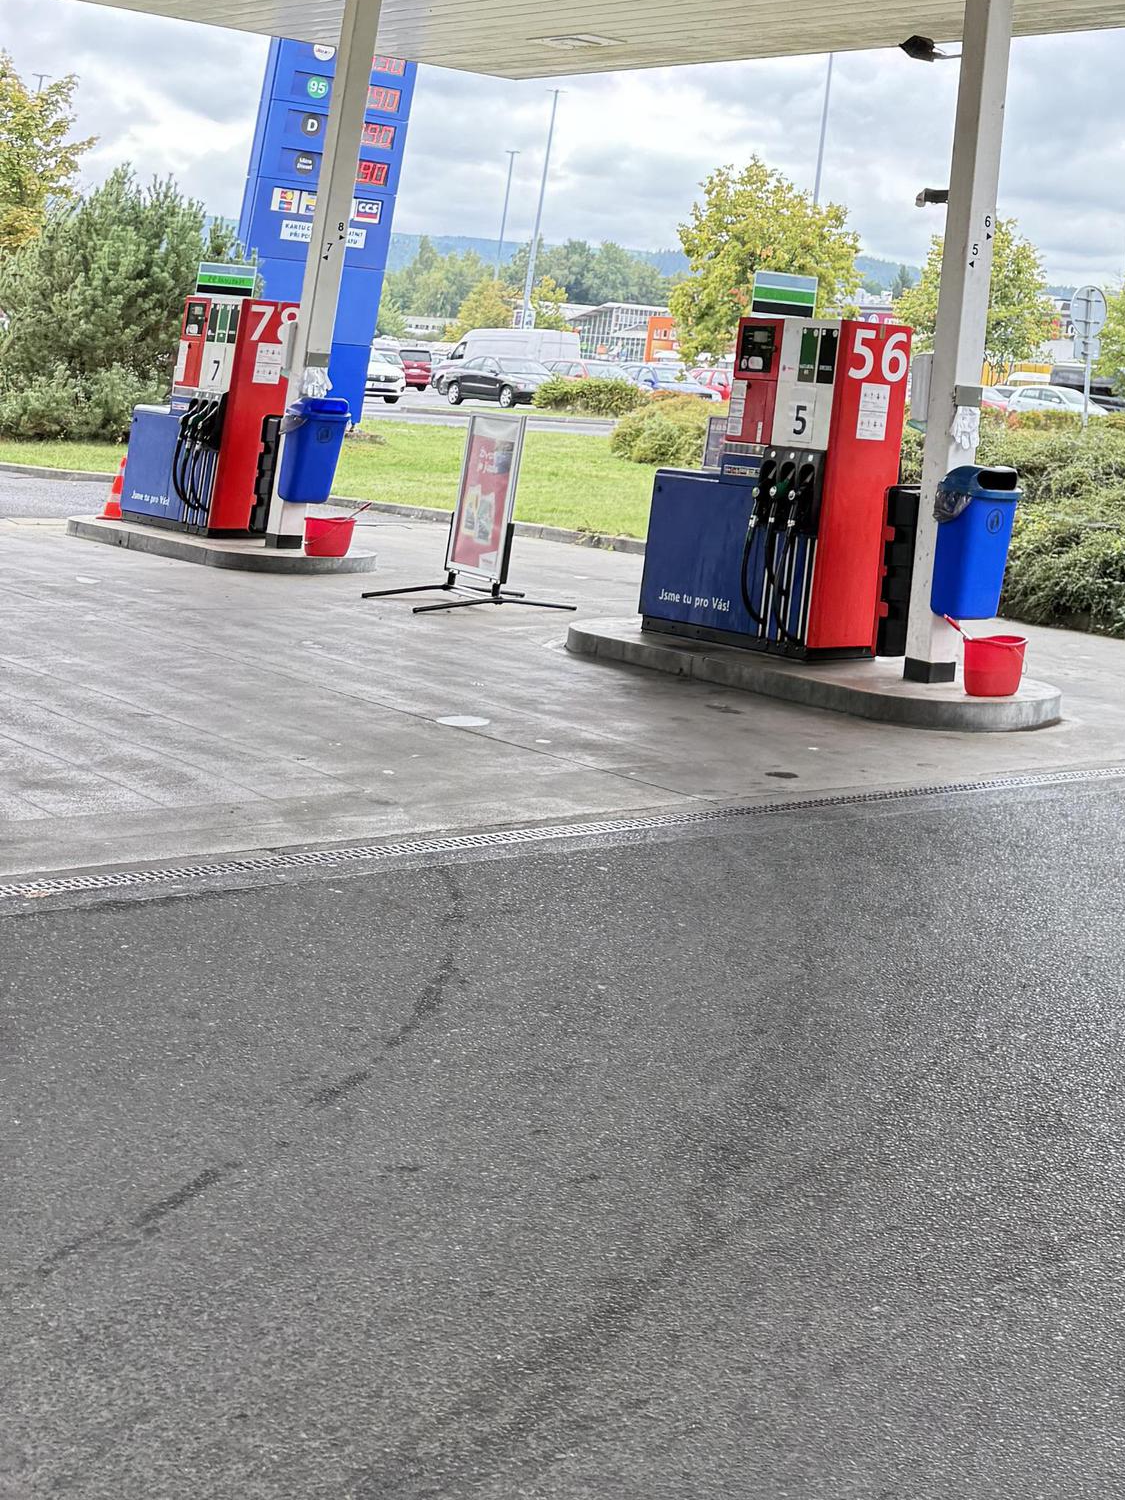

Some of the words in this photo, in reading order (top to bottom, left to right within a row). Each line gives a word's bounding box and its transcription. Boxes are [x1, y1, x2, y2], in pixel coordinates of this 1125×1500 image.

[309, 80, 326, 95] 95
[307, 119, 318, 131] D
[358, 202, 379, 214] CCS
[338, 222, 344, 231] 8
[985, 216, 991, 228] 6
[327, 243, 333, 252] 7
[972, 244, 979, 255] 5
[848, 328, 908, 382] 56
[212, 360, 220, 381] 7
[793, 405, 807, 435] 5
[659, 588, 680, 602] Jsme
[683, 593, 692, 604] tu
[694, 596, 709, 608] pro
[712, 596, 730, 612] Vás!
